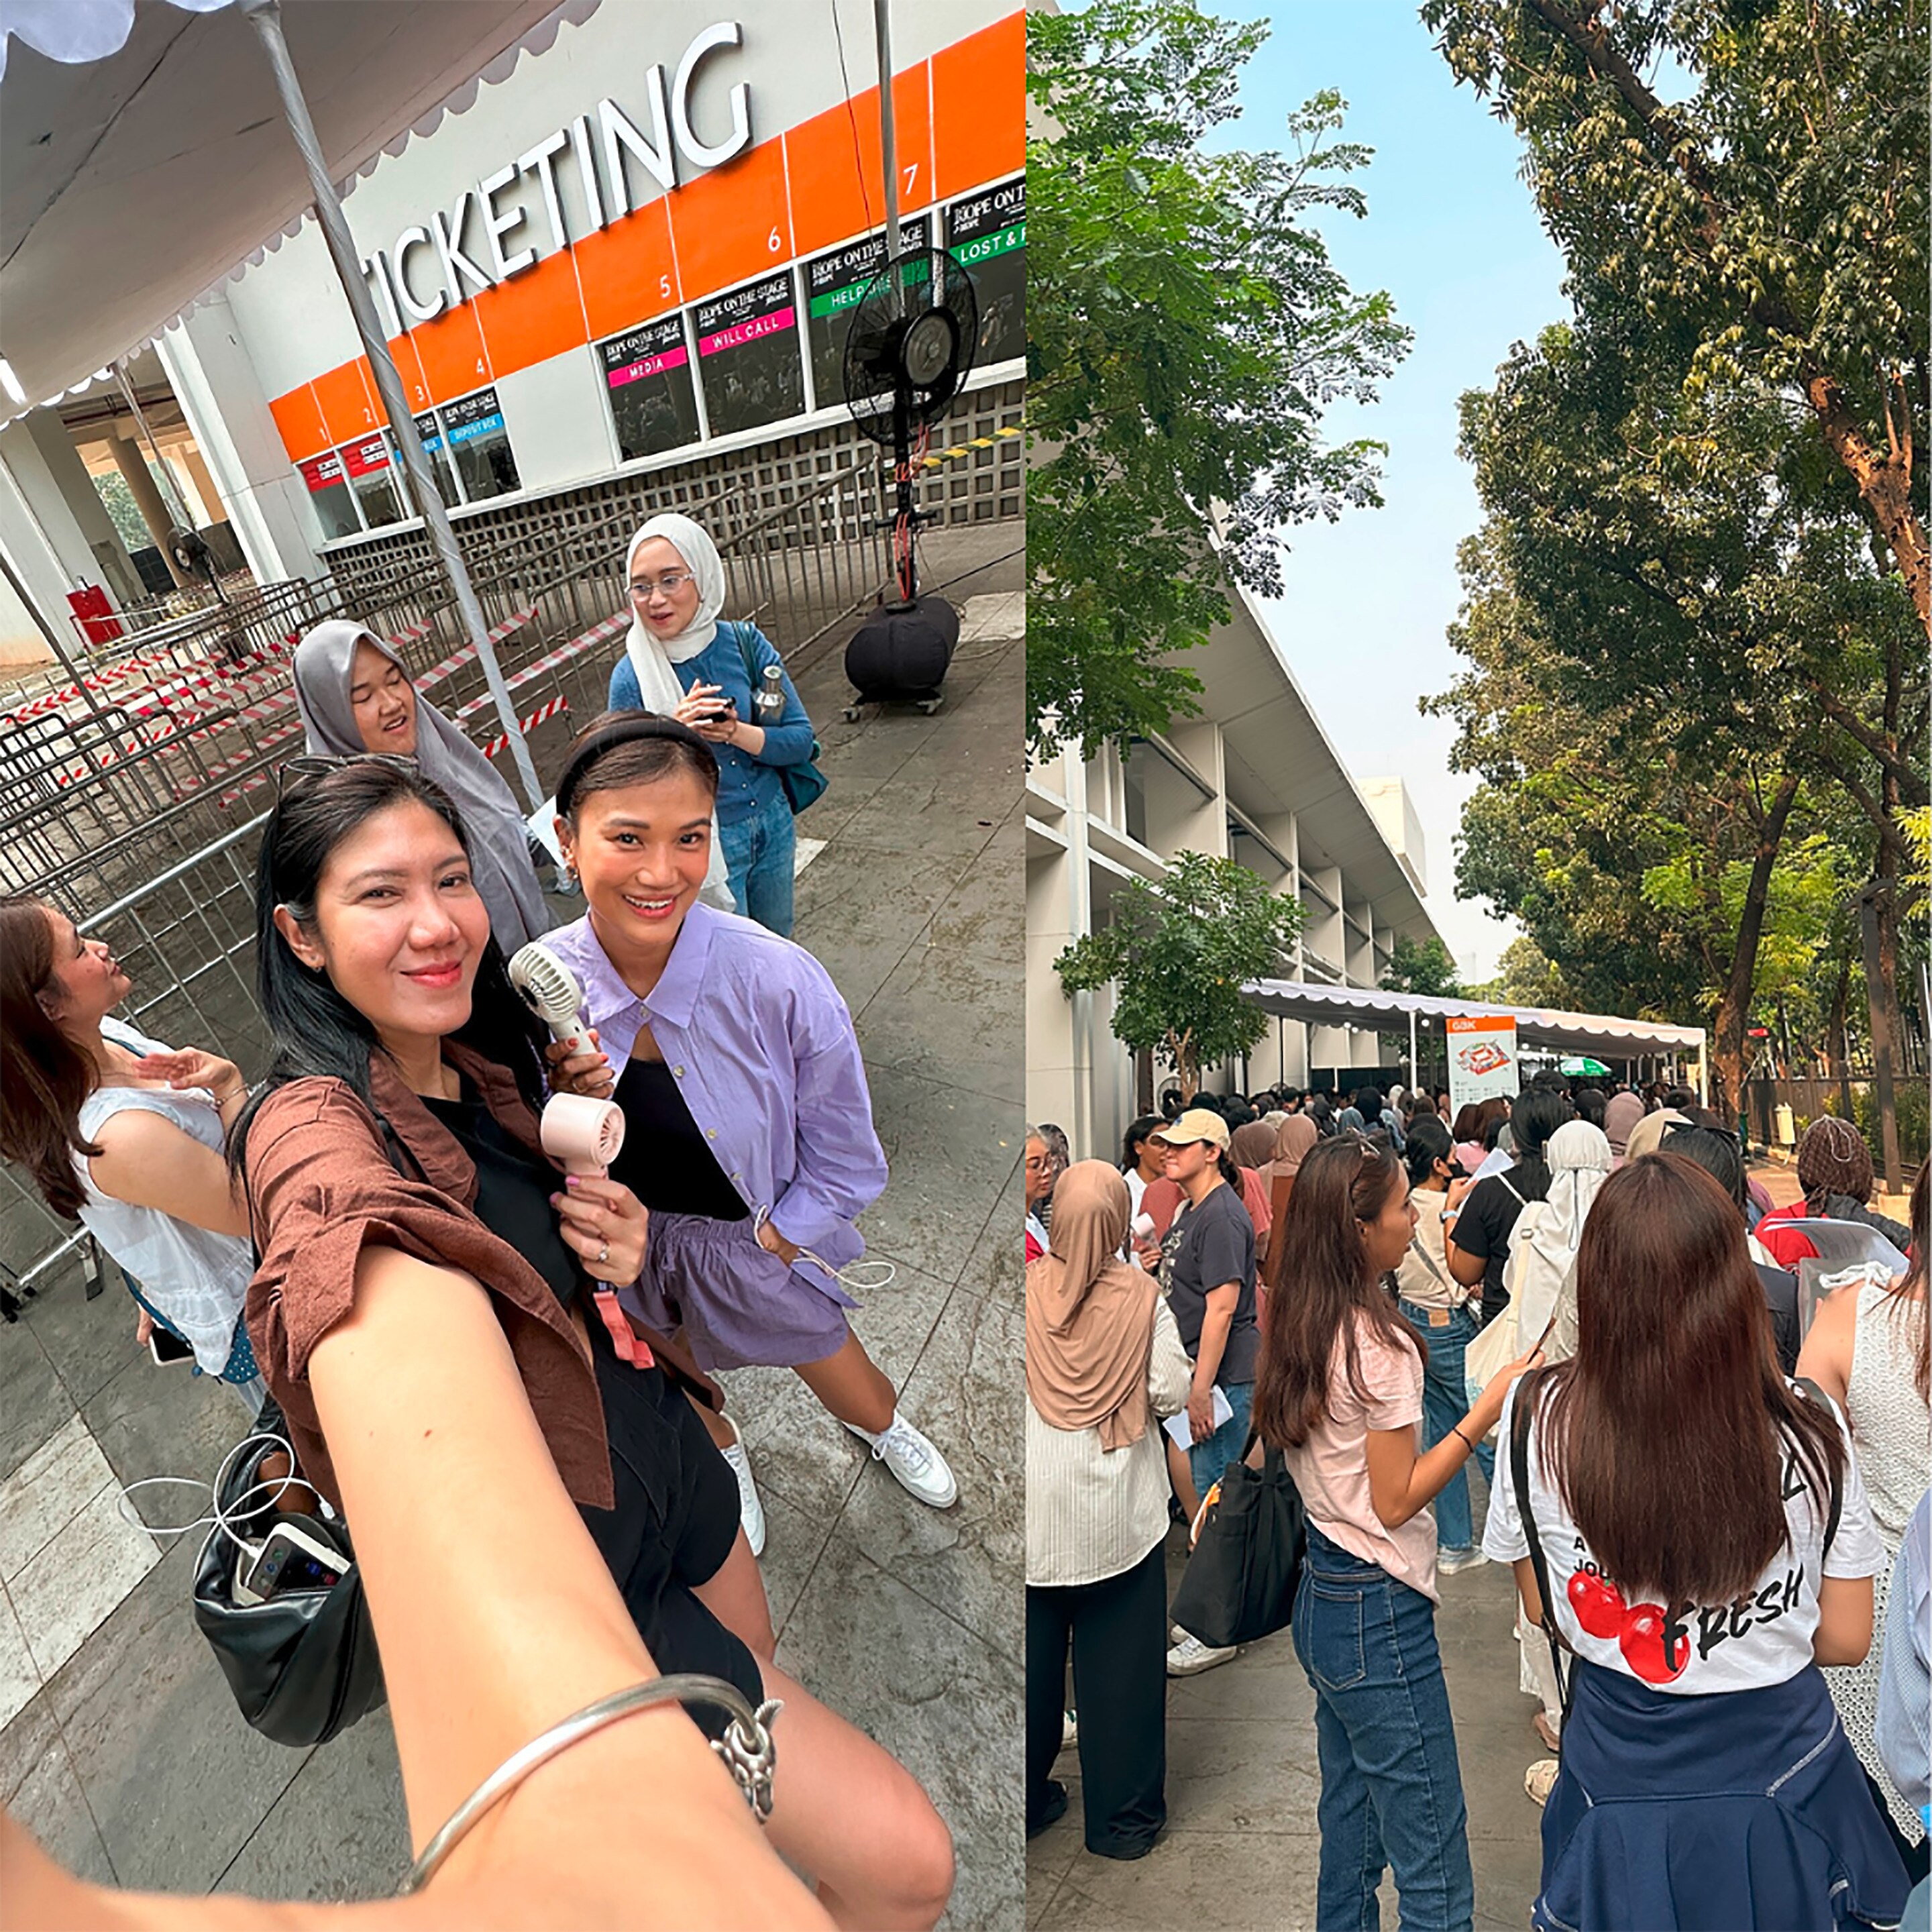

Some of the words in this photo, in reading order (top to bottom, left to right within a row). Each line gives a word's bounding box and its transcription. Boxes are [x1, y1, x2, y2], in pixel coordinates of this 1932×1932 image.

[361, 21, 753, 335] ICKETING
[903, 163, 919, 195] 7
[994, 187, 1015, 209] ON
[767, 225, 782, 253] 6
[961, 235, 1002, 262] LOST
[1006, 231, 1016, 246] &
[659, 274, 671, 298] 5
[831, 285, 864, 307] HELP
[712, 329, 742, 348] WILL
[745, 316, 780, 337] CALL
[476, 358, 486, 376] 4
[629, 358, 663, 378] MEDIA
[415, 385, 425, 401] 3
[363, 409, 372, 424] 2
[319, 427, 327, 441] 1
[1660, 1562, 1804, 1673] FRESH
